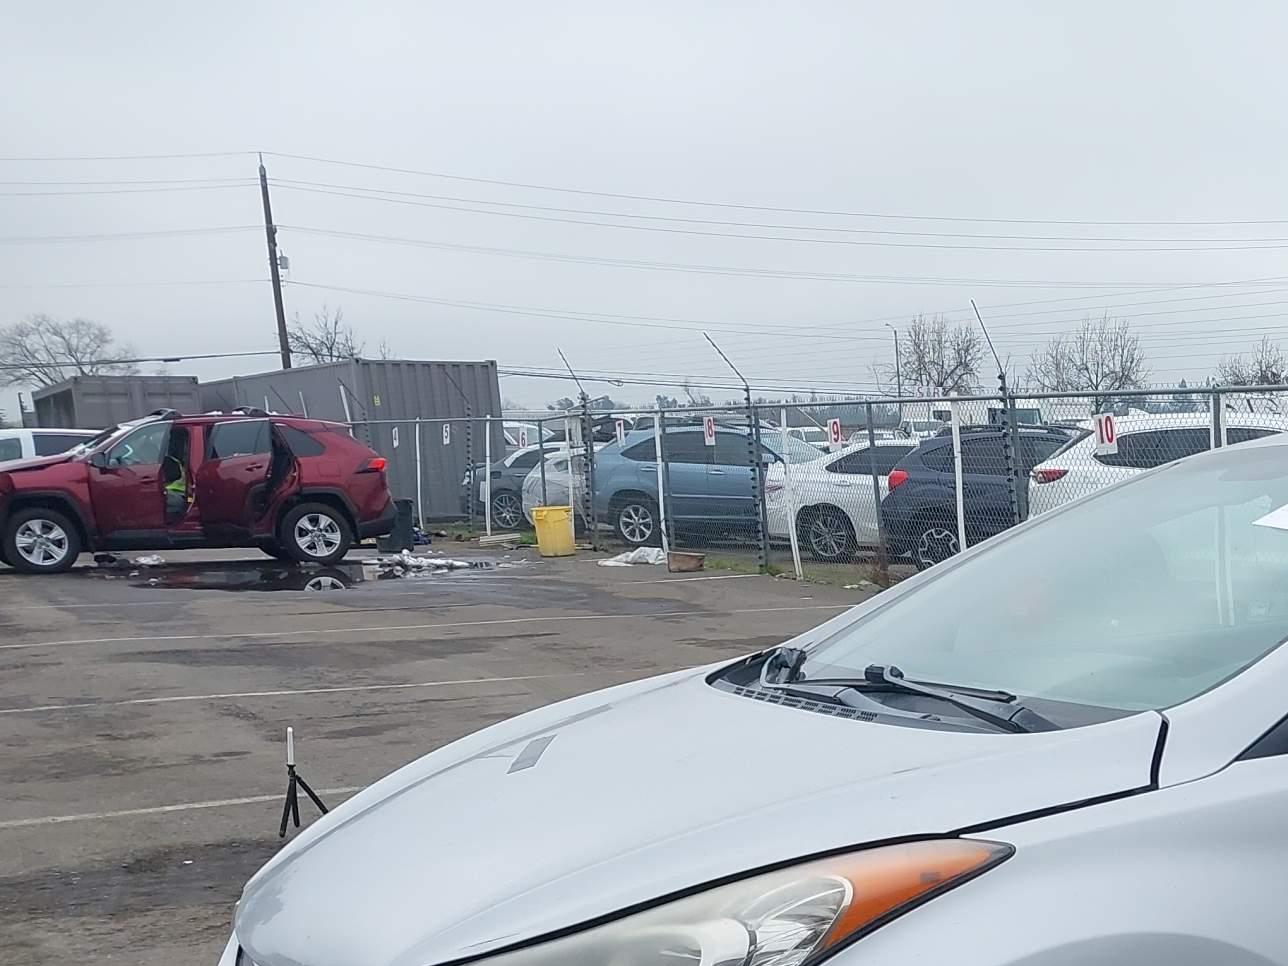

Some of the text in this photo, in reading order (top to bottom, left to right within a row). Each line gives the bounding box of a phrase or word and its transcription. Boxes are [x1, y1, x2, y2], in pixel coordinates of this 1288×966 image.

[707, 419, 713, 438] 8
[832, 420, 840, 442] 9
[1098, 415, 1113, 444] 10
